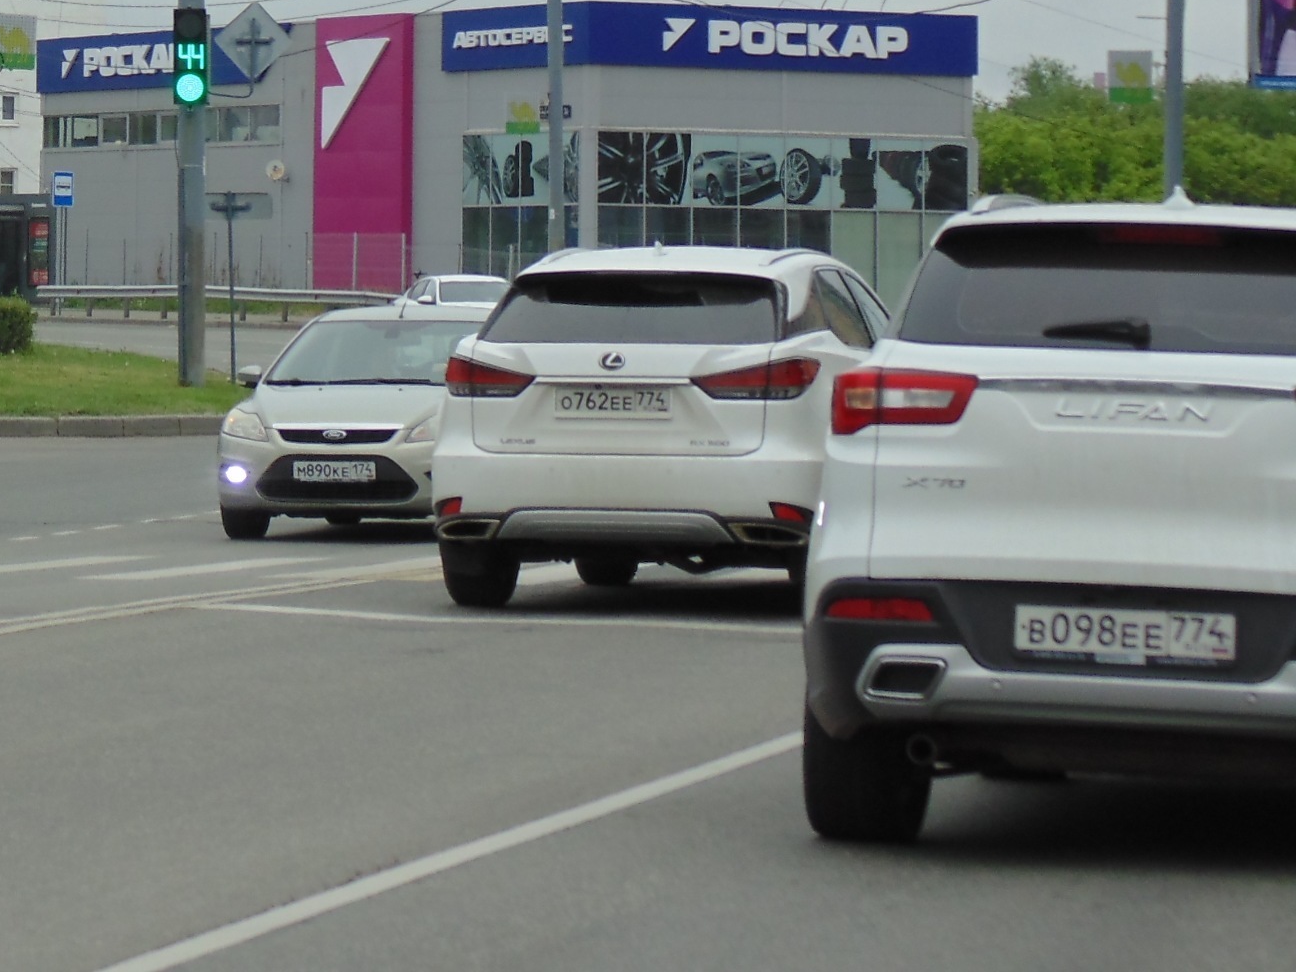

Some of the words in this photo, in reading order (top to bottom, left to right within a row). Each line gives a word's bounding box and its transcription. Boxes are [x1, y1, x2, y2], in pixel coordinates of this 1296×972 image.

[707, 20, 909, 59] РОСКАР
[83, 43, 174, 78] РОСКА
[178, 43, 204, 70] 44
[1055, 399, 1212, 423] LIFAN
